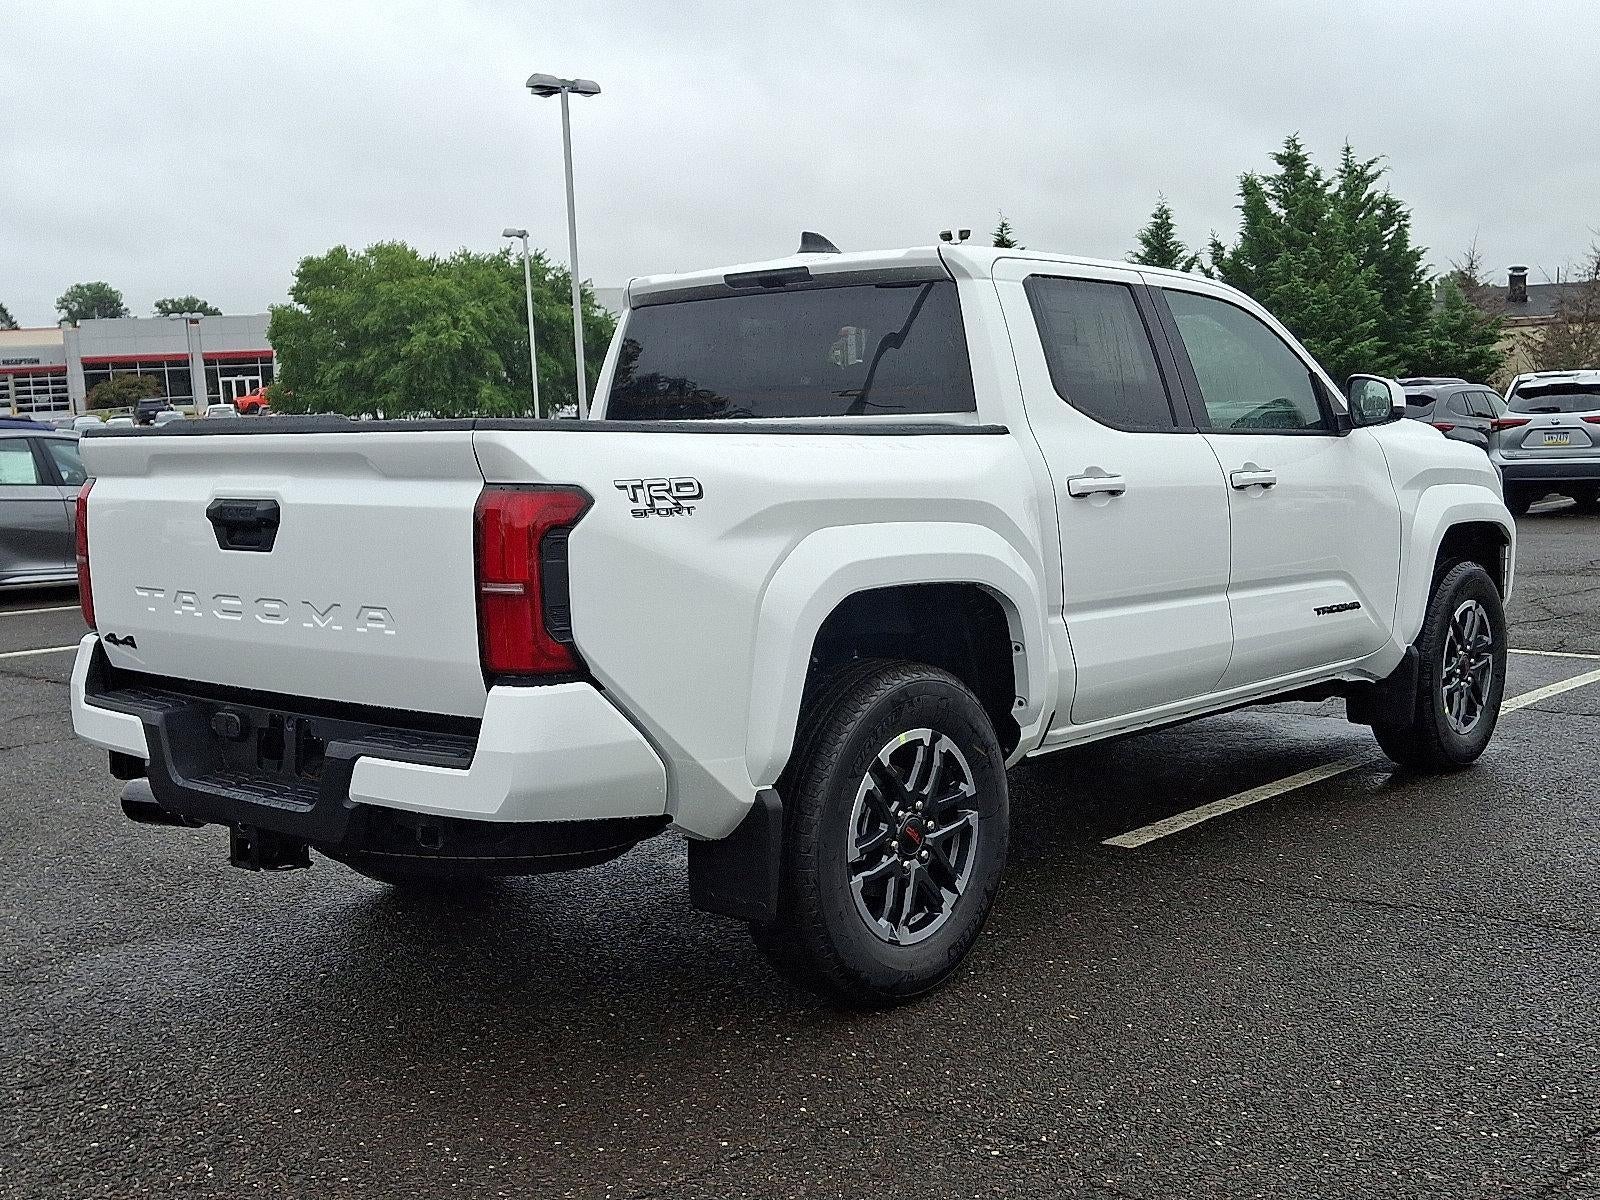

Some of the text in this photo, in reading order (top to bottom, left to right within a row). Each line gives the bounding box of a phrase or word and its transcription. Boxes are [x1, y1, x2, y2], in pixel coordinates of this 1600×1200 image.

[613, 476, 704, 508] TRD
[630, 505, 696, 518] SPORT
[135, 586, 396, 635] TACOMA
[1313, 601, 1361, 615] TACOMA
